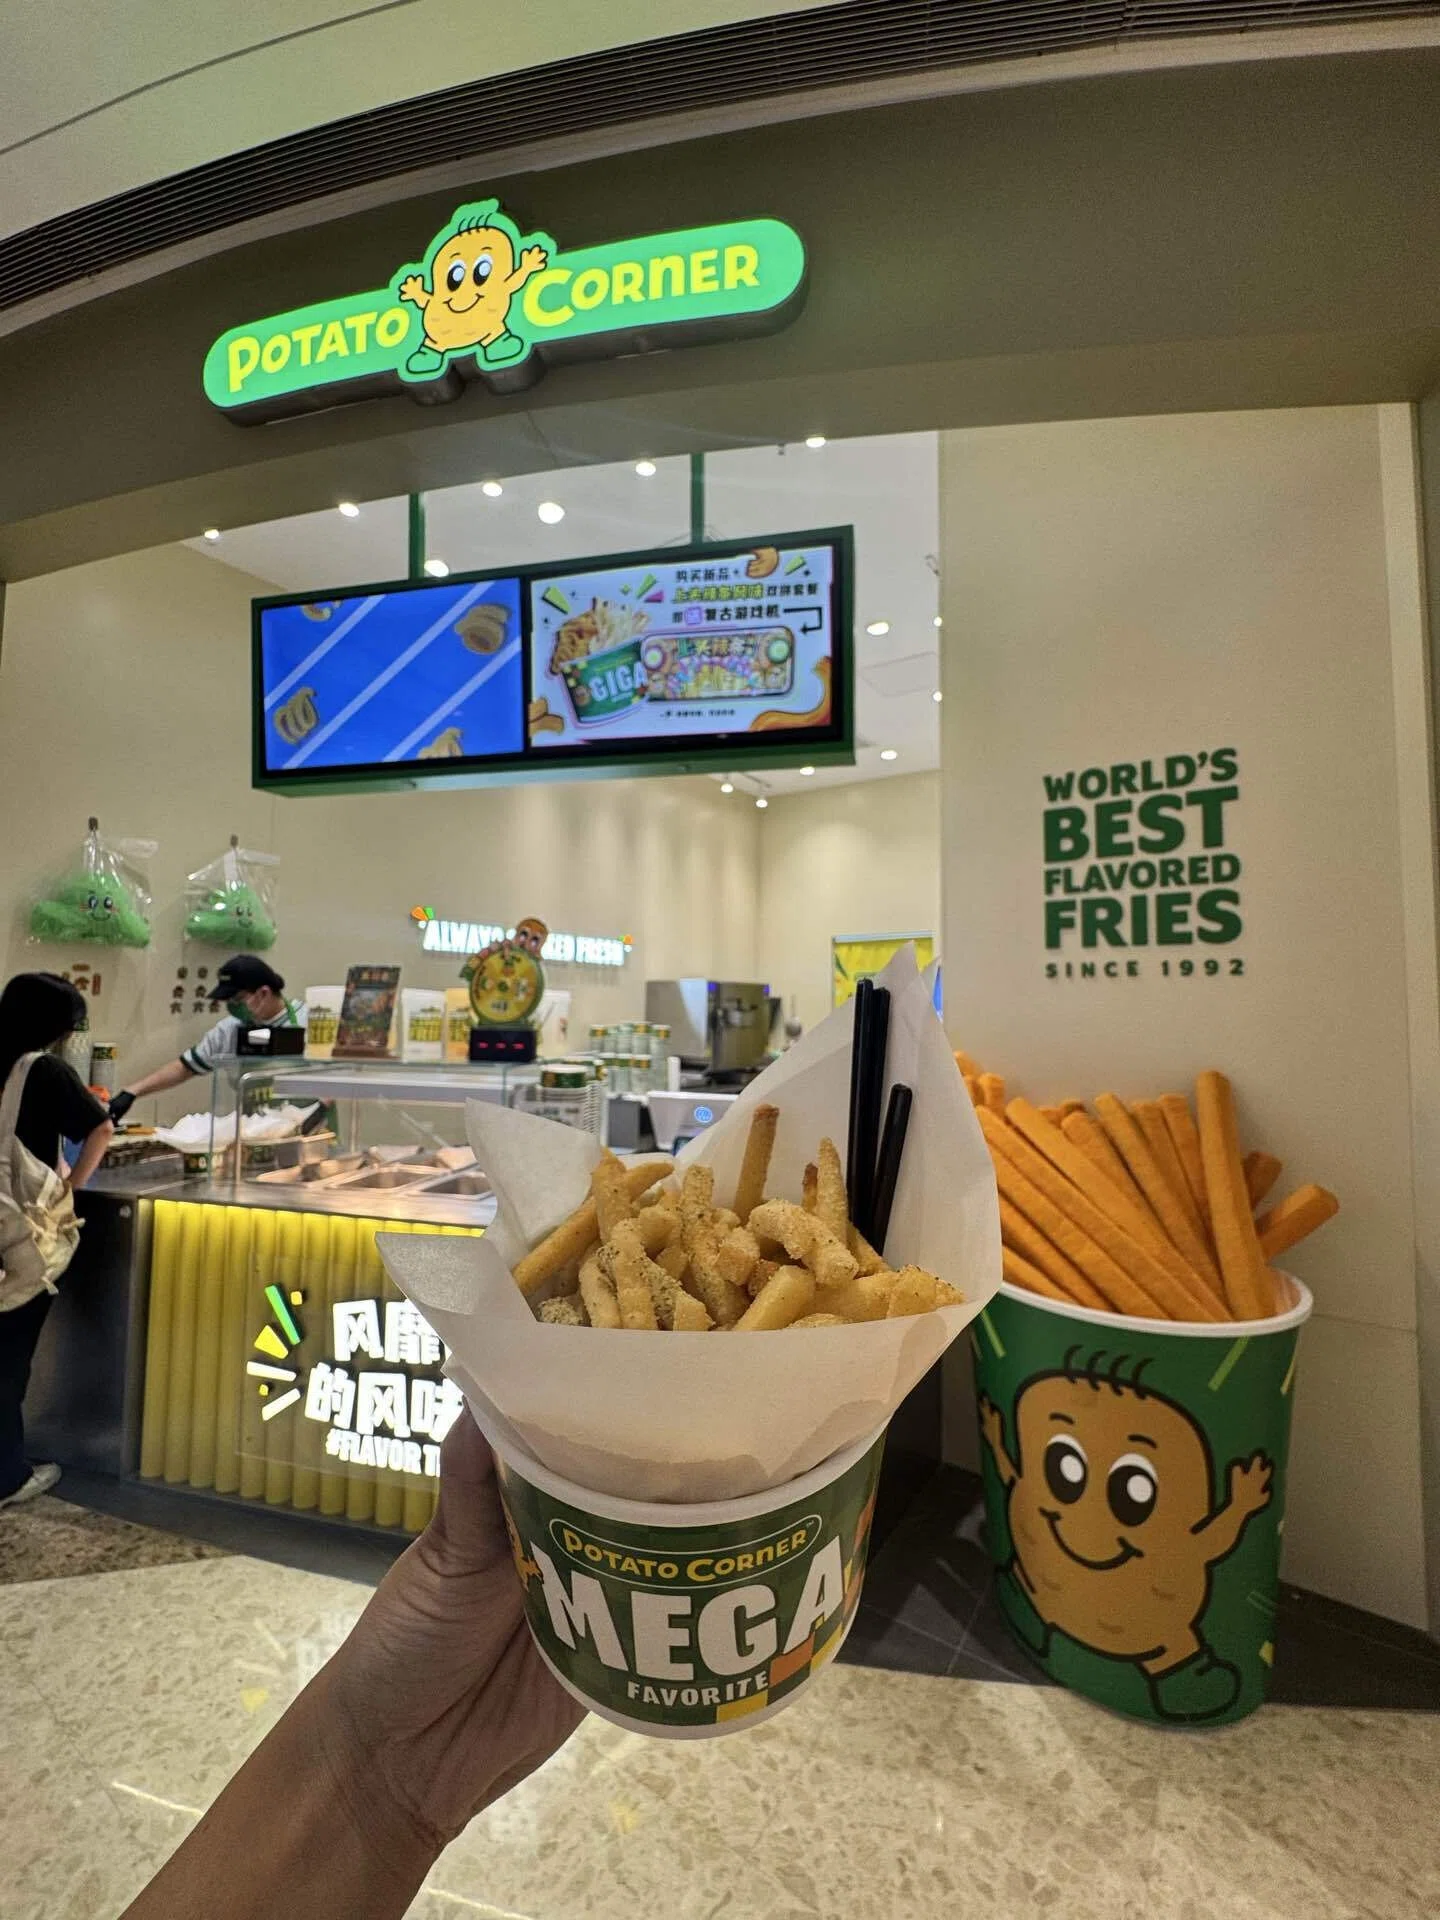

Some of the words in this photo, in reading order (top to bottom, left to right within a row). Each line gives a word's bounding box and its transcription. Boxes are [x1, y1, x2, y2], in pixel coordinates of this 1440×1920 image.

[226, 307, 410, 393] POTATO
[522, 243, 760, 328] CORNER
[588, 661, 648, 702] GIGA
[1043, 747, 1239, 802] WORLD'S
[1043, 785, 1239, 864] BEST
[1044, 853, 1241, 896] FLAVORED
[1044, 888, 1242, 950] FRIES
[1045, 960, 1139, 979] SINCE
[1161, 958, 1245, 977] 1992
[562, 1528, 679, 1580] POTATO
[686, 1529, 808, 1583] CORNER
[529, 1535, 846, 1682] MEGA
[626, 1671, 770, 1707] FAVORITE
